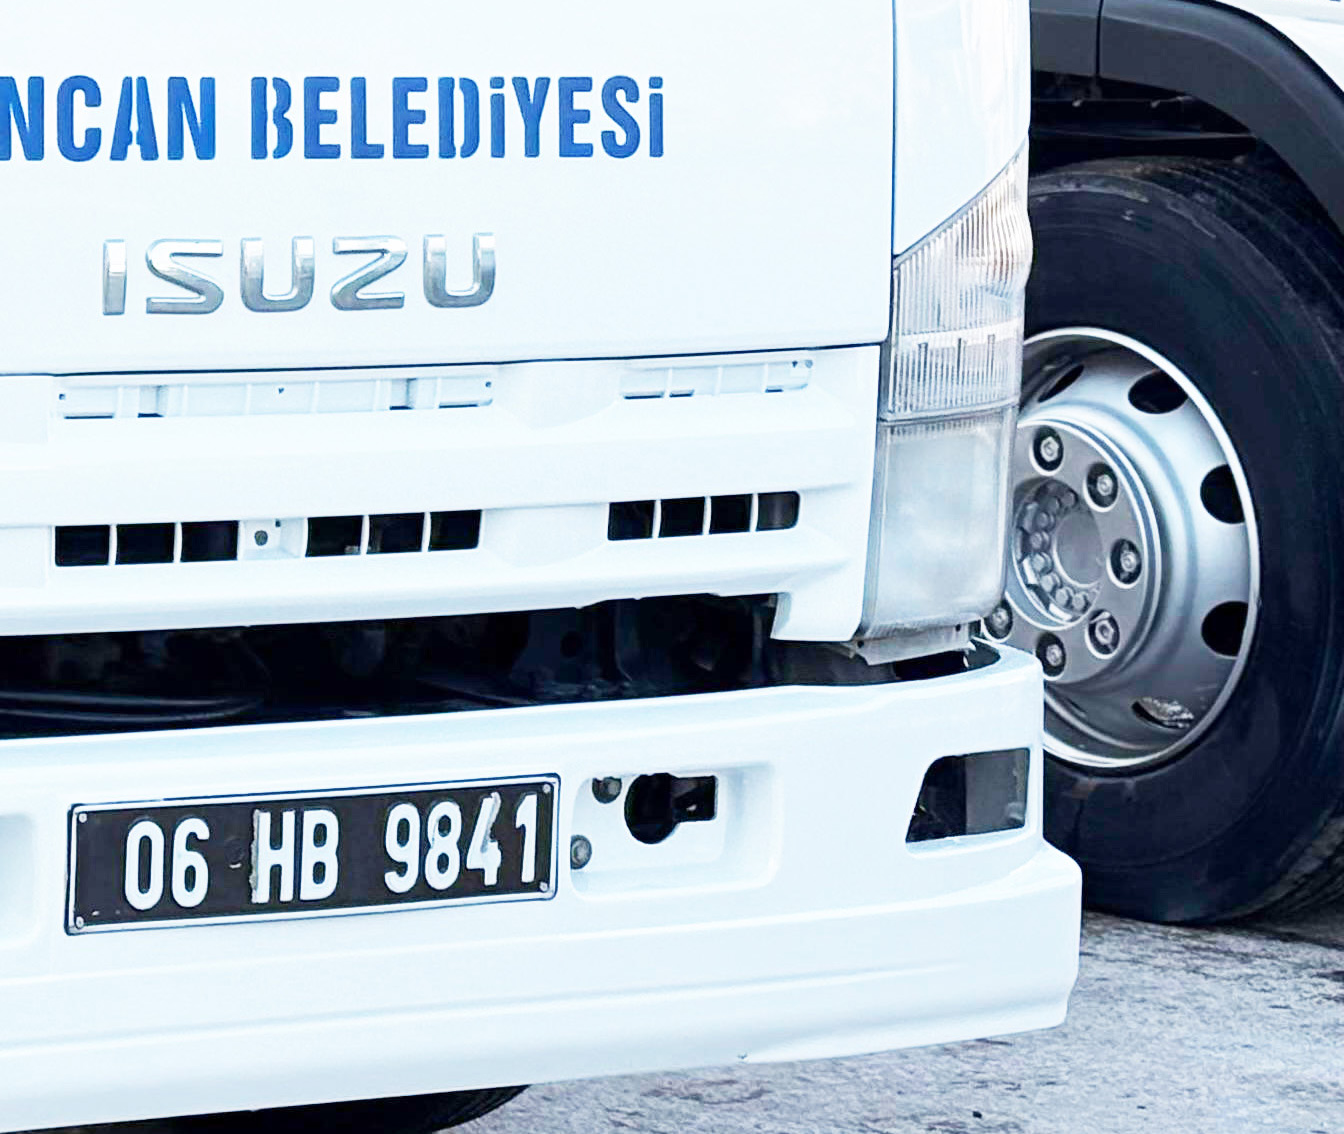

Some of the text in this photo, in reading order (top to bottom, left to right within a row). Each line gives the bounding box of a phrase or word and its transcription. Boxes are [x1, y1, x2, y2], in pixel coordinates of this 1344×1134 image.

[101, 231, 499, 318] ISUZU
[124, 790, 540, 912] 06 HB 9841
